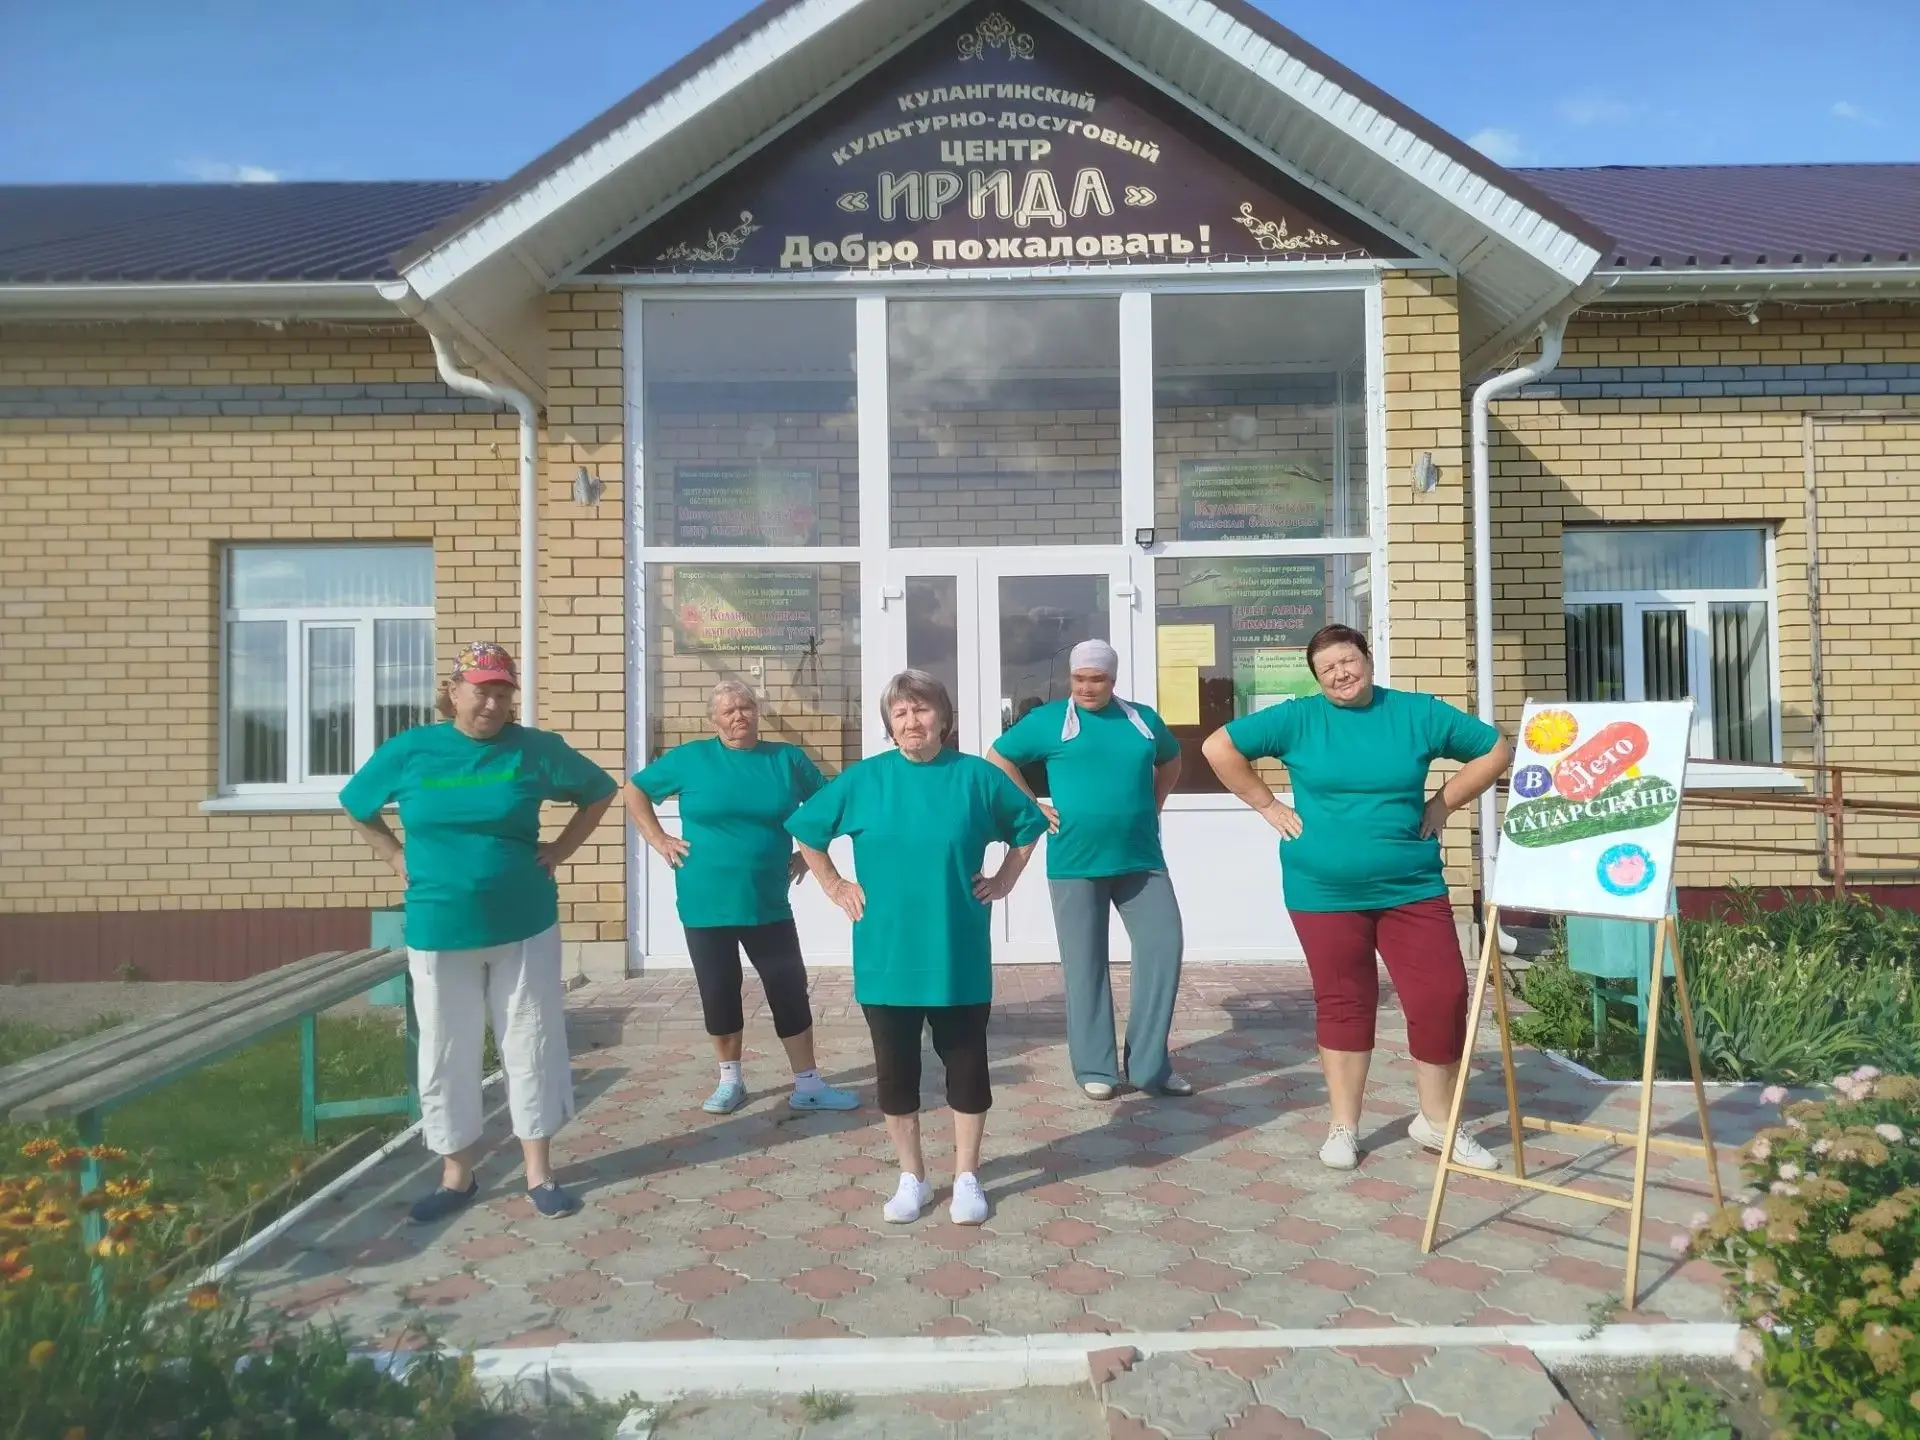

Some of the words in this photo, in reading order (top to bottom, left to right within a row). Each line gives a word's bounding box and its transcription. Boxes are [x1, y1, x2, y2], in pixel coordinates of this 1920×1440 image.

[897, 84, 1096, 112] КУЛАНГИНСКИЙ
[832, 111, 1161, 166] КУЛЬТУРНО-ДОСУГОВЫЙ
[940, 139, 1052, 166] ЦЕНТР
[780, 235, 919, 270] Добро
[932, 225, 1211, 261] пожаловать!
[1504, 786, 1678, 834] ТАТАРСТАНЕ
